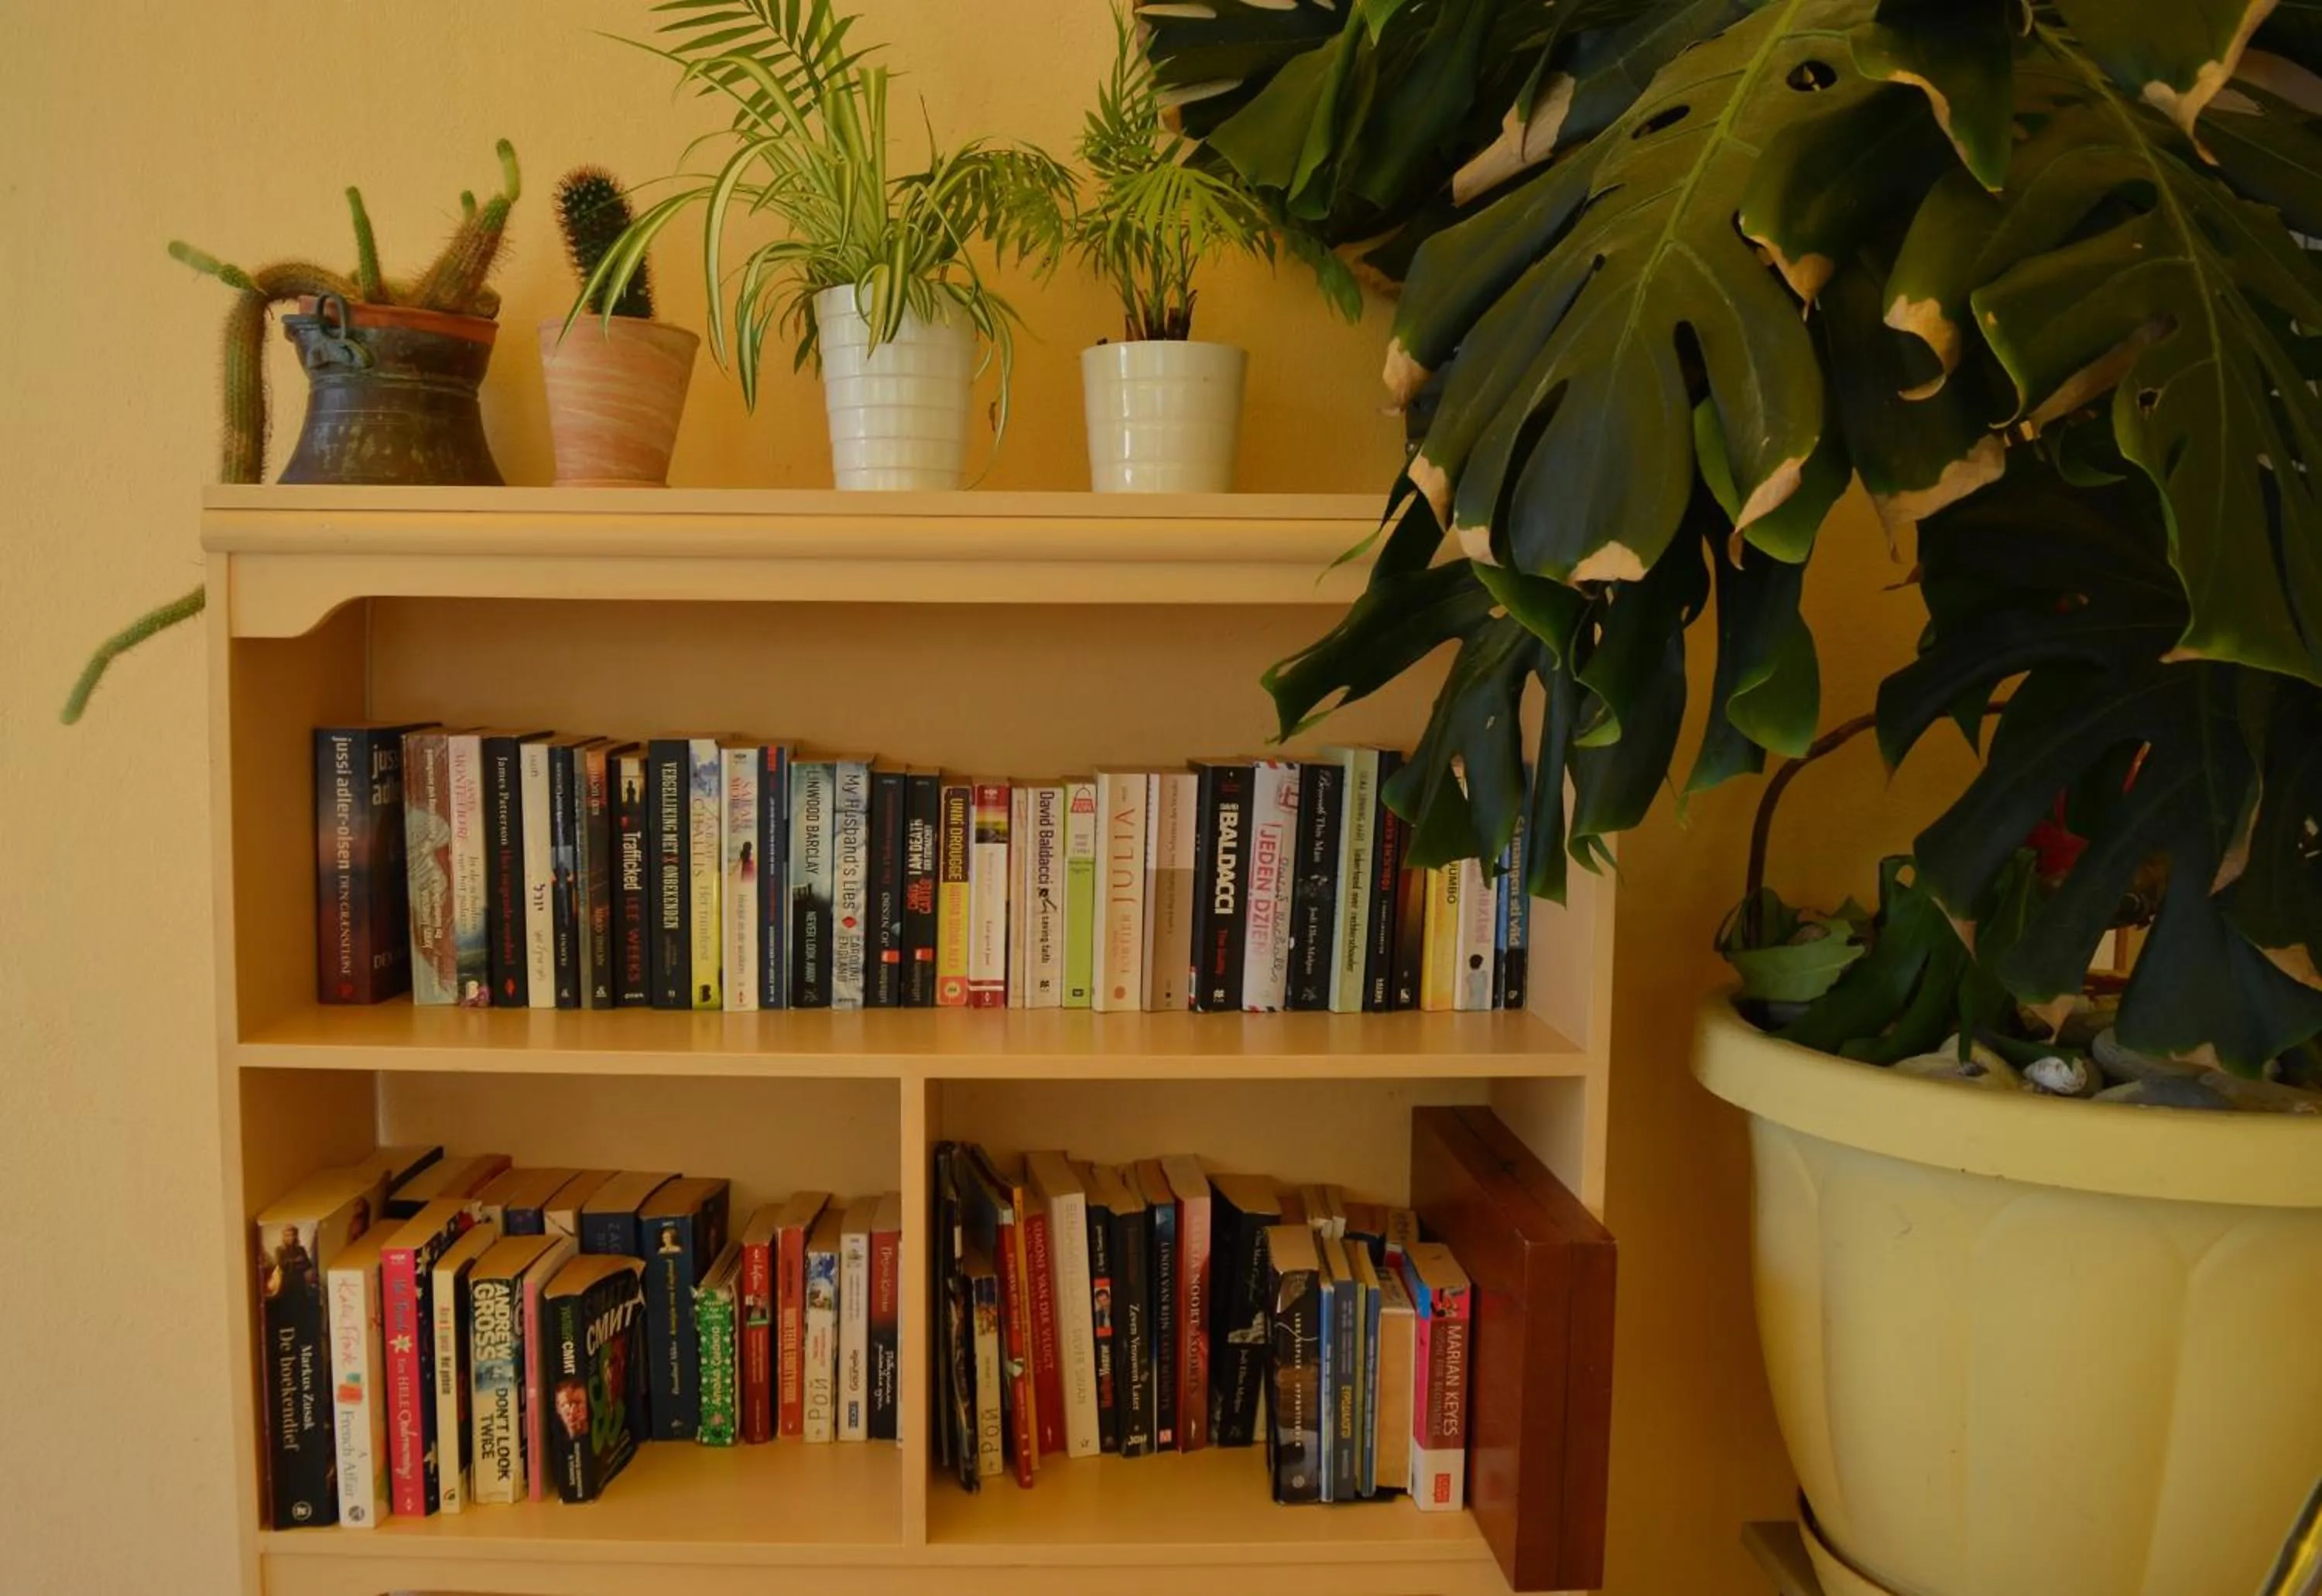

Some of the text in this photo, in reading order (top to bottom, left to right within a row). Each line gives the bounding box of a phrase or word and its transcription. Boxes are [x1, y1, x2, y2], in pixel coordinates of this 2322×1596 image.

[332, 736, 354, 869] jussi adler-olsen
[496, 756, 510, 845] James Patterson
[741, 780, 754, 830] SARAH
[803, 770, 820, 874] LINWOOD BARCLAY
[908, 819, 923, 852] DEATH
[1315, 817, 1327, 839] This
[622, 831, 641, 891] Trafficked
[662, 834, 678, 854] MET
[662, 855, 679, 864] X
[693, 798, 707, 877] CHALLIS
[841, 774, 861, 909] My Husband's Lies
[908, 854, 923, 869] AM
[947, 827, 964, 880] DROUGGE
[1038, 791, 1055, 885] David Baldacci
[1111, 808, 1136, 904] JULIA
[1214, 811, 1239, 914] BALDACCI
[1256, 829, 1277, 892] JEDEN
[1313, 841, 1324, 864] Man
[663, 865, 679, 930] ONBEKENDEN
[626, 896, 641, 982] LEE WEEKS
[804, 911, 817, 982] NEVER LOOK AWAY
[837, 936, 849, 982] ENGLAND
[848, 935, 860, 981] CAROLINE
[880, 931, 890, 947] JO
[1039, 916, 1051, 964] saving faith
[474, 1283, 495, 1361] GROSS
[1037, 1273, 1051, 1300] VAN
[1159, 1242, 1172, 1331] LINDA VAN RIJN
[1190, 1273, 1201, 1327] NOORT
[495, 1285, 511, 1360] ANDREW
[1128, 1303, 1142, 1412] Zeven Vrouwen Later
[278, 1327, 300, 1452] De boekendief
[300, 1344, 315, 1430] Markus Zusak
[1443, 1324, 1462, 1436] MARIAN KEYES
[341, 1410, 358, 1498] French Affair
[481, 1413, 494, 1460] TWICE
[495, 1388, 511, 1481] DON'T LOOK
